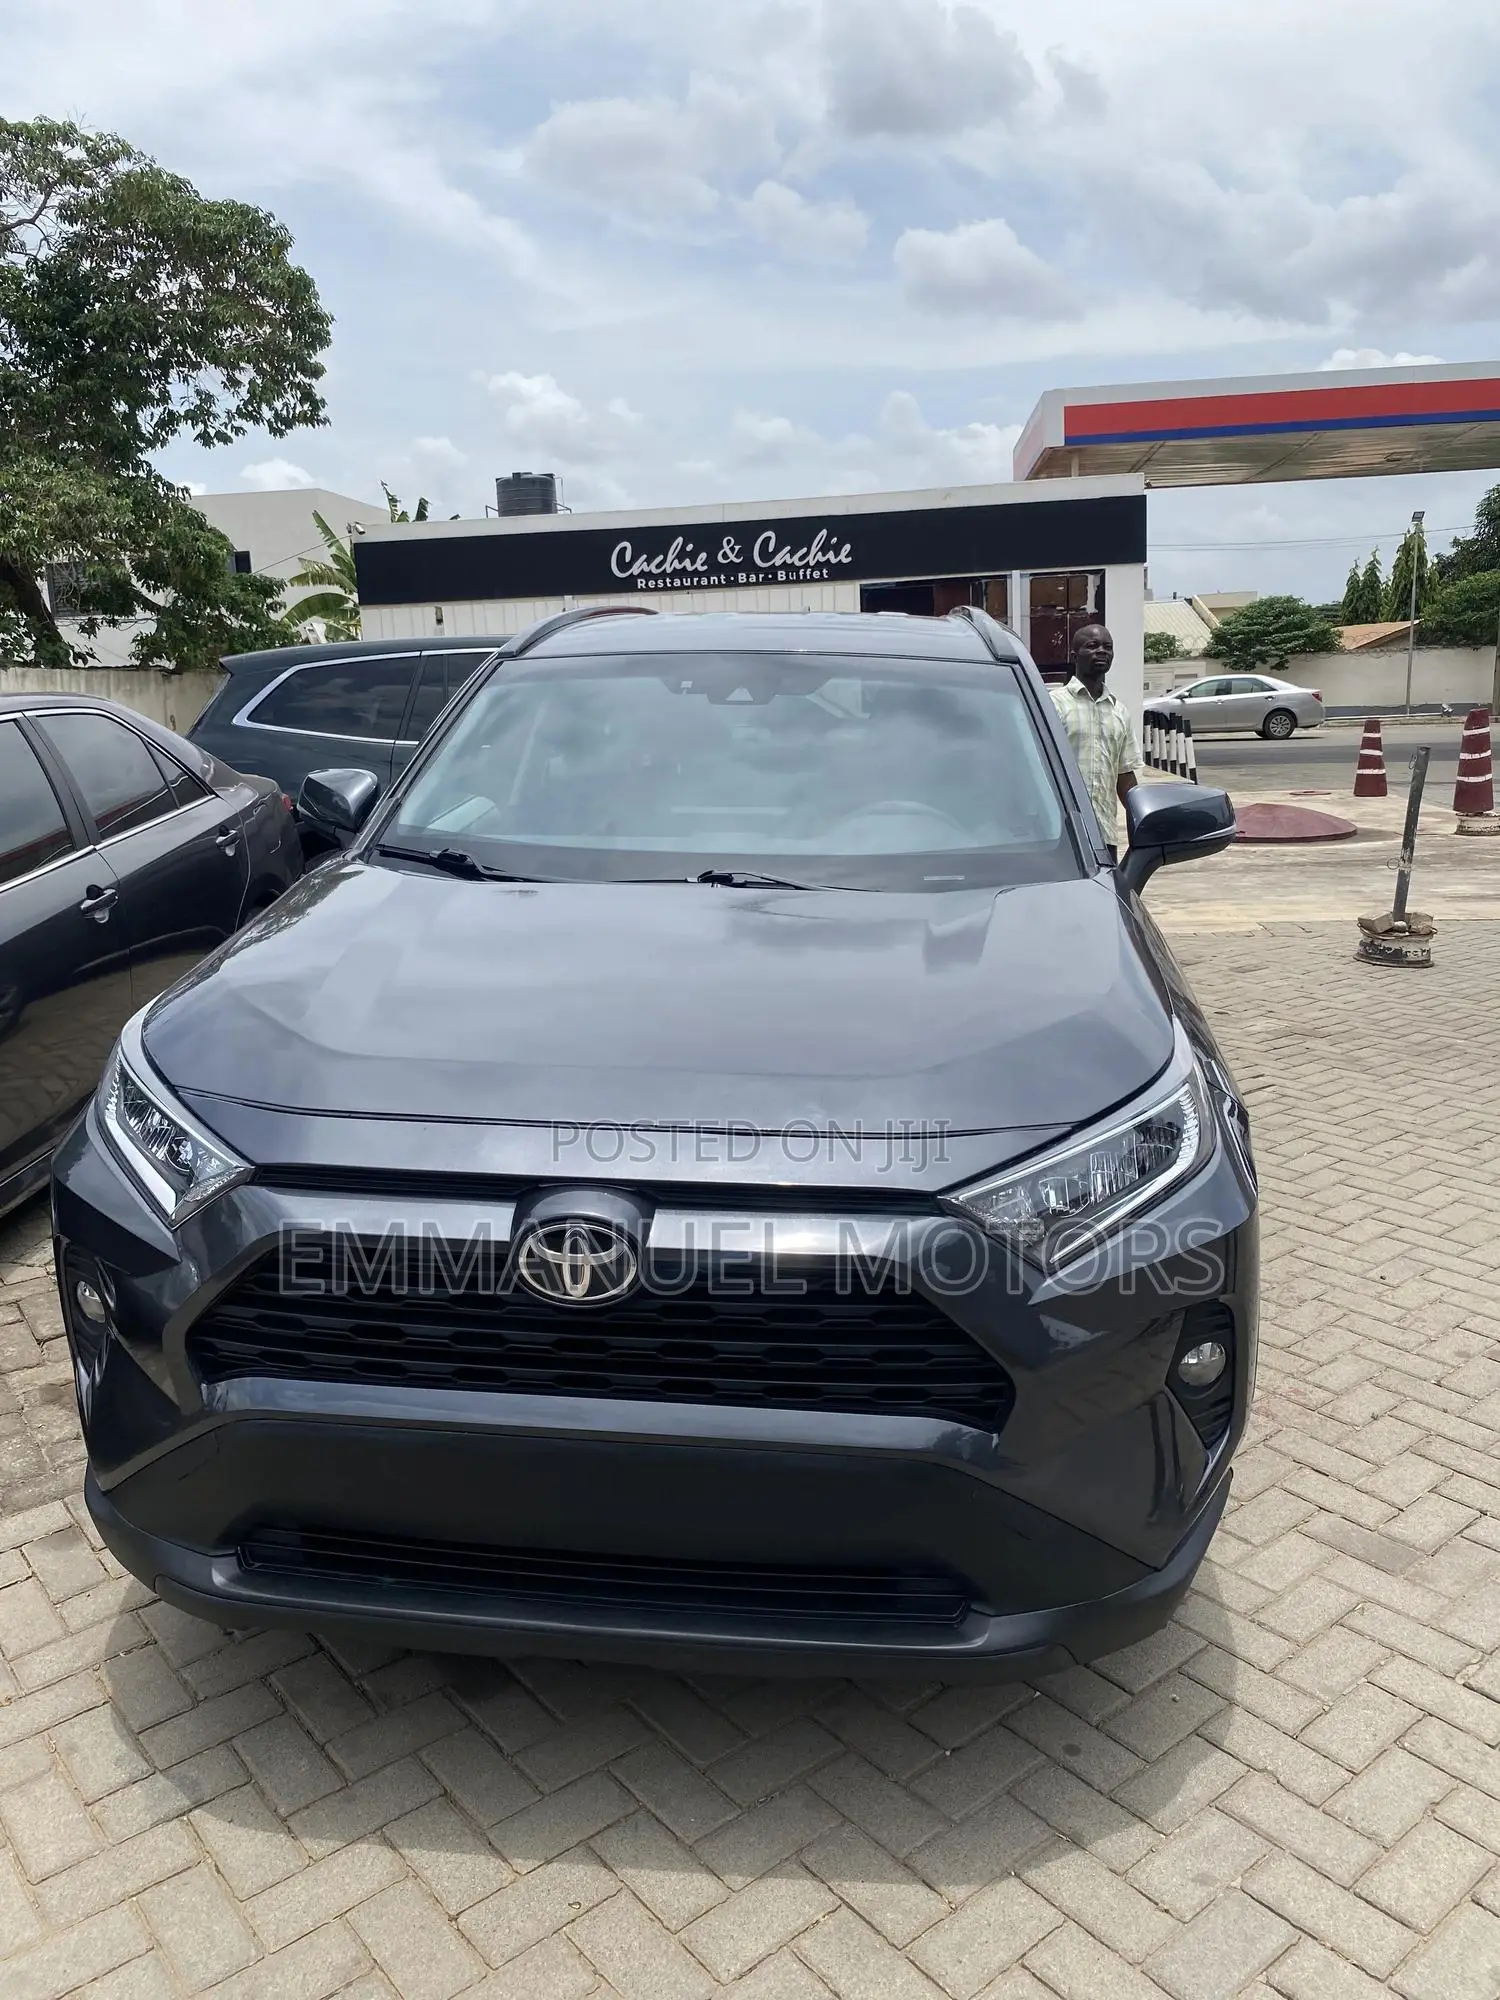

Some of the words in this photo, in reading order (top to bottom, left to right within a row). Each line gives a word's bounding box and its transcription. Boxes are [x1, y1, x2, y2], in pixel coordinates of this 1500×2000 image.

[610, 536, 708, 578] Cachie
[717, 536, 744, 564] &
[753, 528, 853, 567] Cachie
[637, 575, 726, 589] Restaurant
[738, 572, 764, 583] Bar
[777, 568, 829, 581] Buffet
